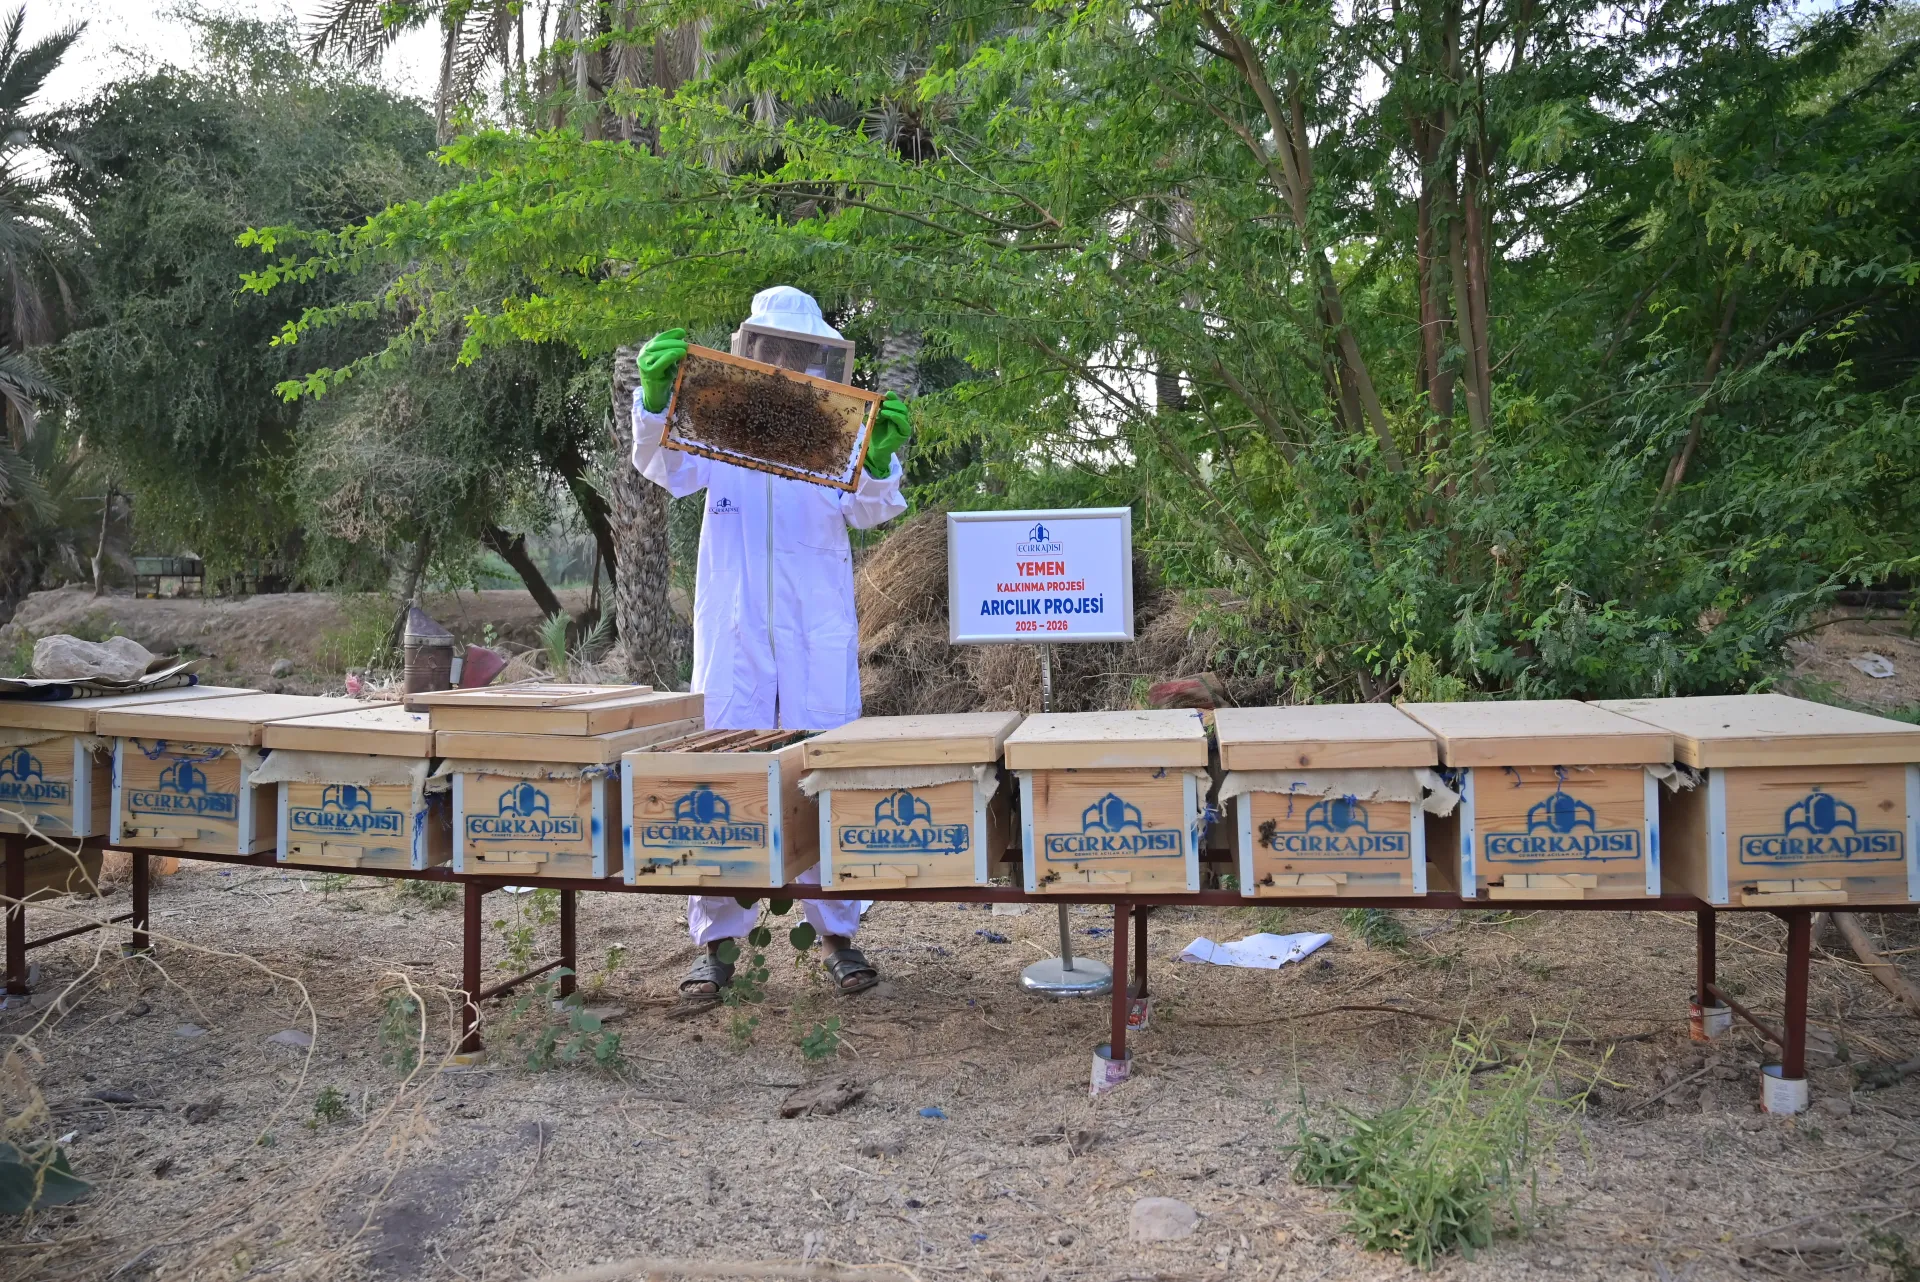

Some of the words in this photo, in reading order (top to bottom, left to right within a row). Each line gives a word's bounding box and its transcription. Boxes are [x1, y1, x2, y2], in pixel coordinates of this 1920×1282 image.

[1016, 561, 1065, 576] YEMEN
[997, 582, 1045, 592] KALKINMA
[1047, 578, 1085, 591] PROJESİ
[980, 599, 1041, 616] ARICILIK
[1044, 593, 1104, 614] PROJESİ
[1015, 621, 1037, 631] 2025
[1046, 620, 1068, 631] 2026
